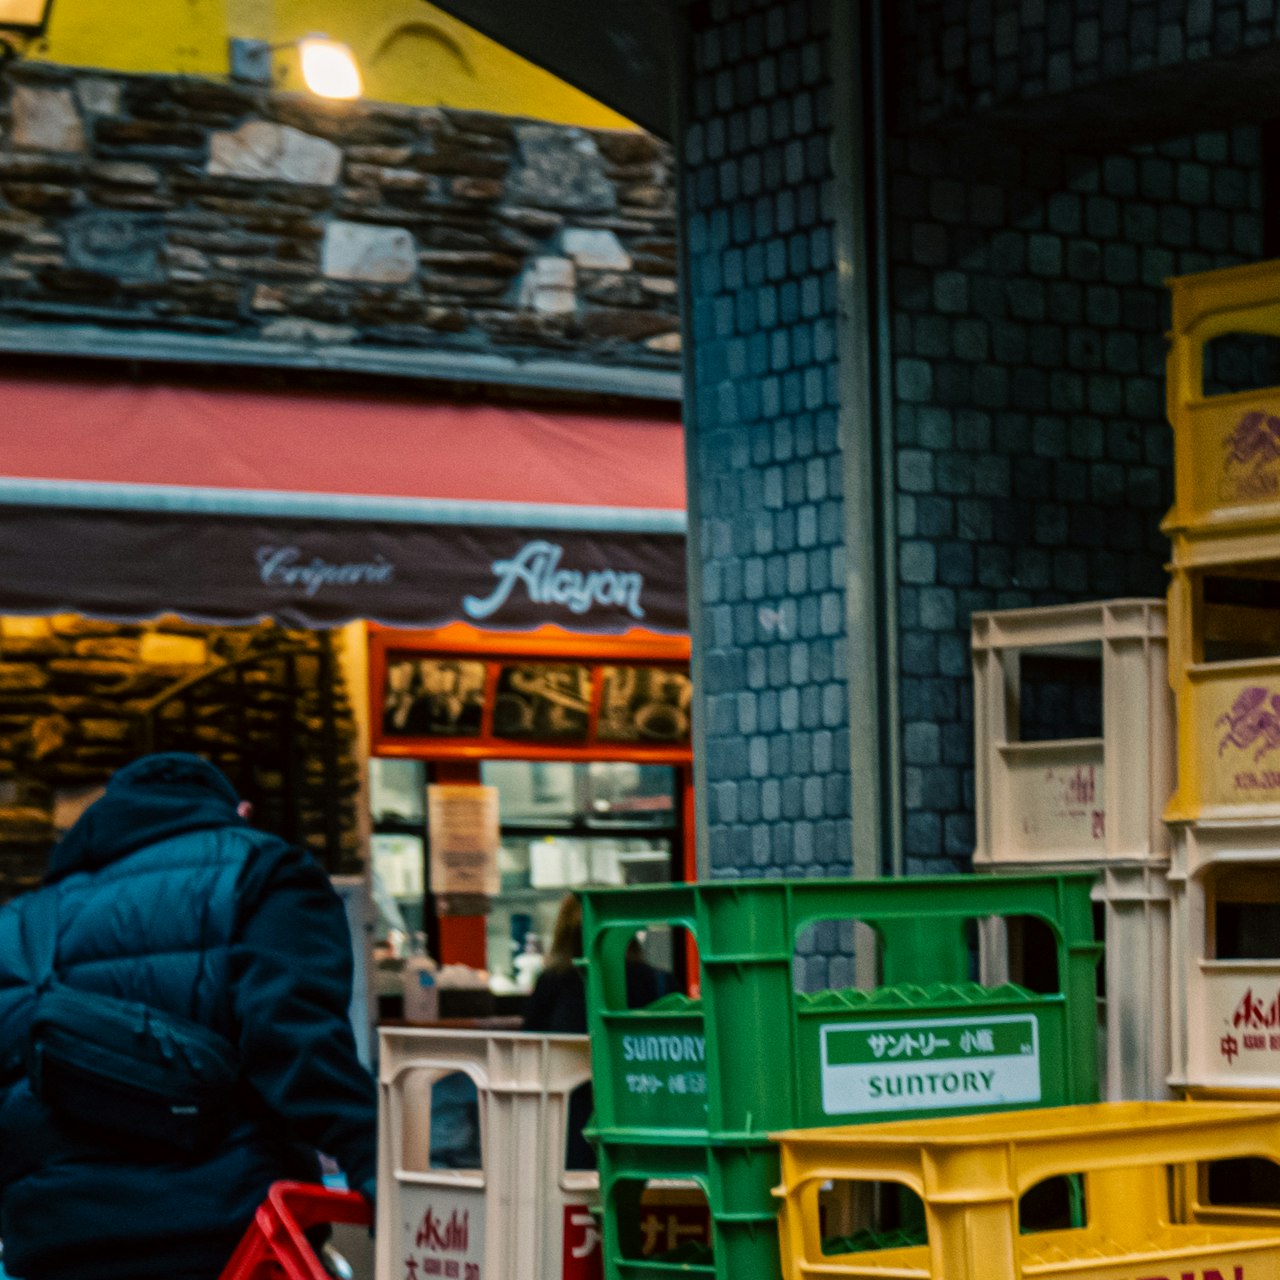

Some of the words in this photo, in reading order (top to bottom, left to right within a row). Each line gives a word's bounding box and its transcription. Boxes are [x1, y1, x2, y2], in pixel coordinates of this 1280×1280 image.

[464, 540, 645, 619] Alcyon
[623, 1034, 705, 1063] SUNTORY
[867, 1031, 950, 1059] サントリー
[1220, 1034, 1239, 1065] 中
[868, 1070, 996, 1099] SUNTORY
[416, 1204, 468, 1251] Asahi
